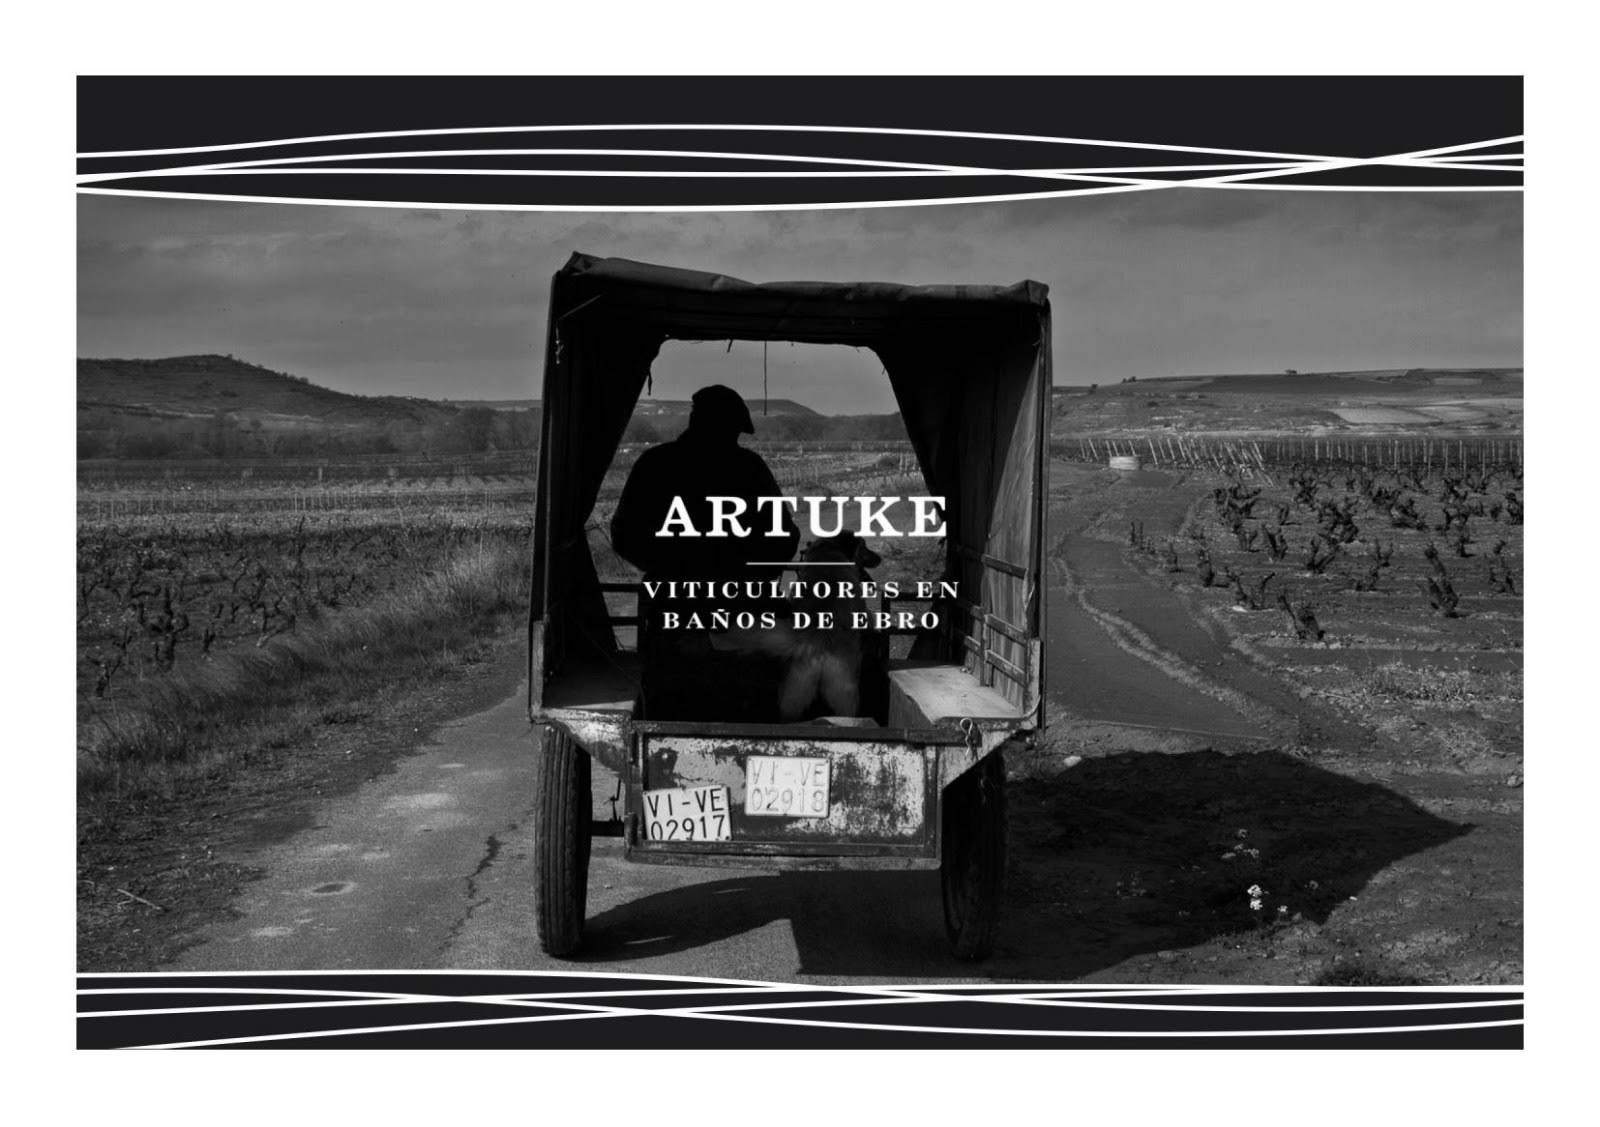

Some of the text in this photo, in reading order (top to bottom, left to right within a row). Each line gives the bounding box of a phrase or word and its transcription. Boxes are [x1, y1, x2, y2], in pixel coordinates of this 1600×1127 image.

[751, 759, 826, 787] VI-VE
[647, 788, 725, 818] VI-VE
[751, 788, 826, 813] 02918
[650, 814, 726, 841] 02917
